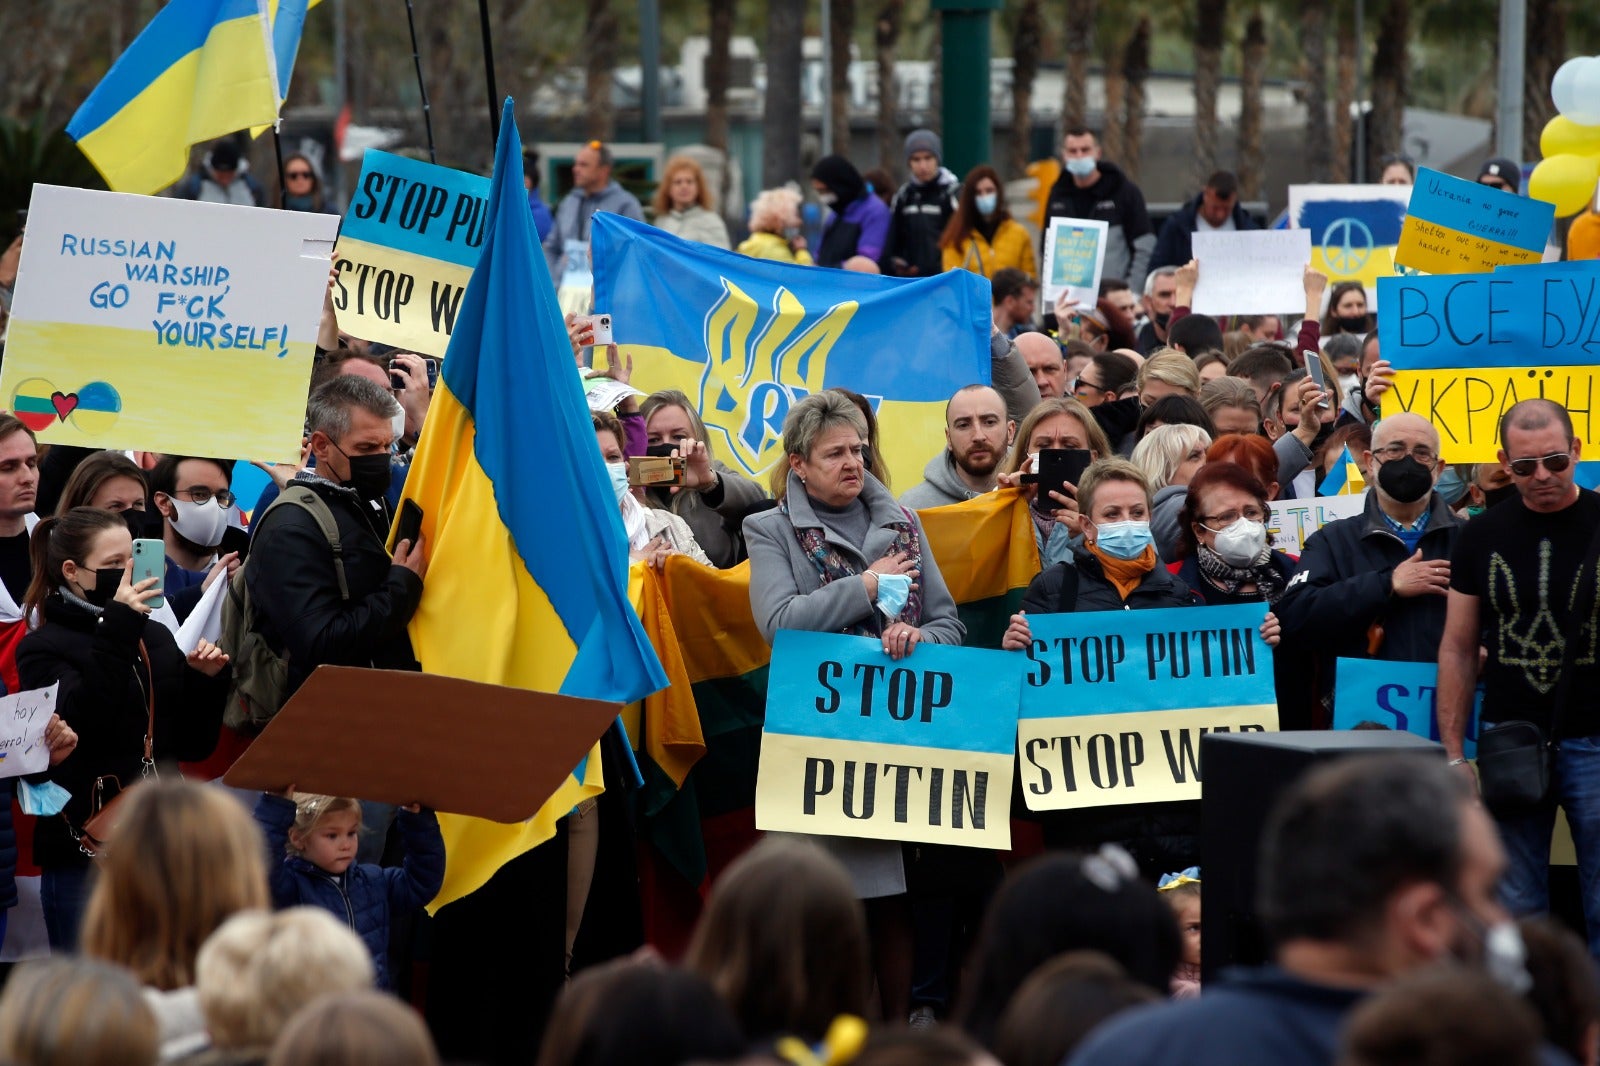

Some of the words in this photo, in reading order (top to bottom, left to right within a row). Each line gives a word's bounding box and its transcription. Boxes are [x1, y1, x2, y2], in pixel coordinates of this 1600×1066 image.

[355, 171, 448, 235] STOP
[1429, 178, 1471, 204] Ucrania
[61, 233, 176, 261] RUSSIAN
[1418, 240, 1451, 256] handle
[89, 280, 130, 309] GO
[125, 263, 231, 295] WARSHIP,
[334, 258, 415, 324] STOP
[430, 280, 465, 336] W
[152, 319, 288, 358] YOURSELF!
[1400, 280, 1515, 347] ВСЕ
[1392, 369, 1600, 445] УКРАЇН
[1025, 634, 1125, 687] STOP
[1146, 627, 1256, 680] PUTIN
[14, 697, 38, 723] hoy
[815, 660, 954, 723] STOP
[1025, 731, 1144, 795] STOP
[803, 757, 989, 830] PUTIN
